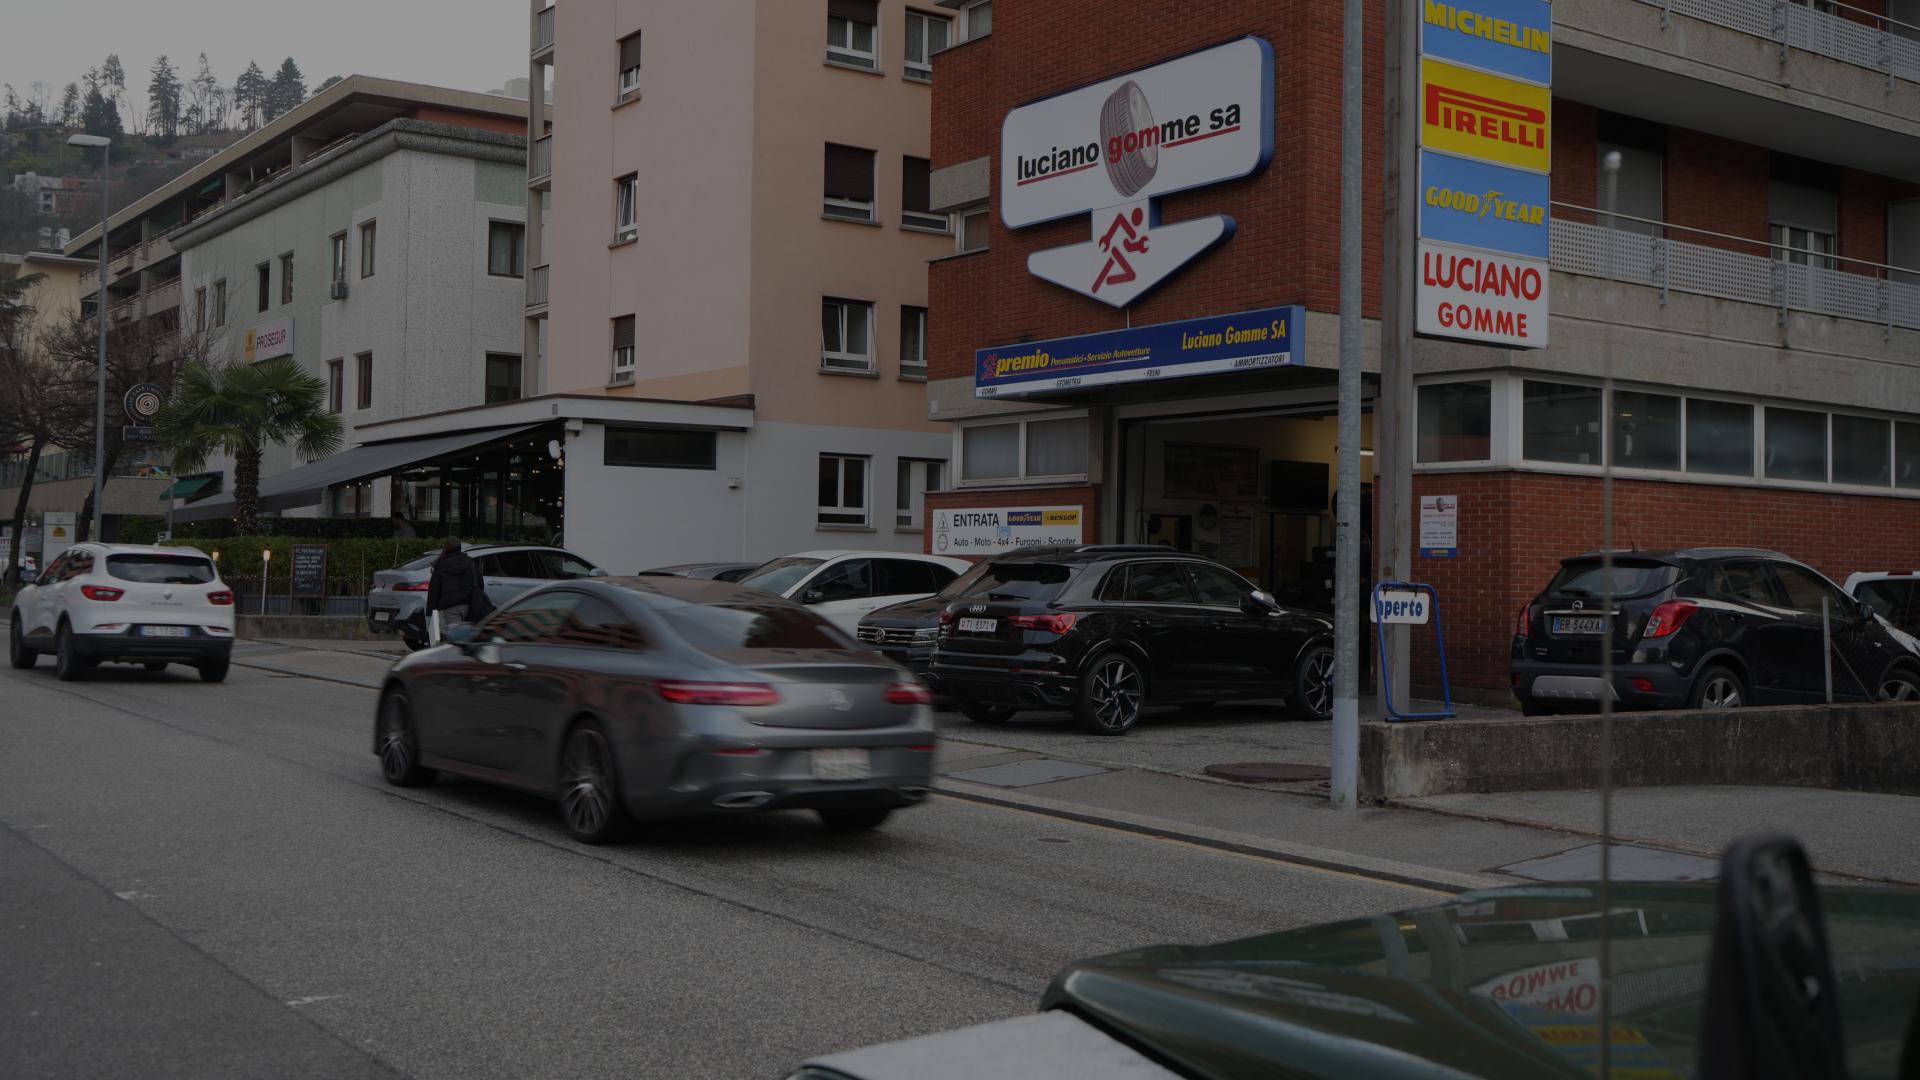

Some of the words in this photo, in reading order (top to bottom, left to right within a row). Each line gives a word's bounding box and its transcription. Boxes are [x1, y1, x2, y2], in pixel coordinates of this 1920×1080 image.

[1424, 0, 1550, 55] MICHELIN
[1425, 82, 1546, 150] PIRELLI
[1016, 142, 1100, 180] luciano
[1107, 114, 1201, 164] gomme
[1208, 103, 1241, 130] sa
[1424, 251, 1542, 301] LUCIANO
[1438, 301, 1528, 338] GOMME
[257, 329, 287, 349] PROSEGUR
[1181, 330, 1222, 350] Luciano
[1225, 325, 1268, 345] Gomme
[1270, 319, 1287, 339] SA
[995, 348, 1050, 377] premio
[1112, 347, 1151, 359] Autovetture
[1233, 354, 1285, 368] AMMORTIZZATORI
[1056, 377, 1082, 388] GEOMETRIA
[1145, 368, 1161, 377] FRENI
[981, 386, 998, 396] GOMME
[953, 513, 1000, 527] ENTRATA
[953, 537, 969, 547] Auto
[974, 537, 992, 547] Moto
[997, 537, 1010, 547] 4x4
[1015, 537, 1042, 546] Furgoni
[1048, 537, 1077, 545] Scooter
[1559, 619, 1571, 630] ER
[1573, 619, 1600, 630] 344XA
